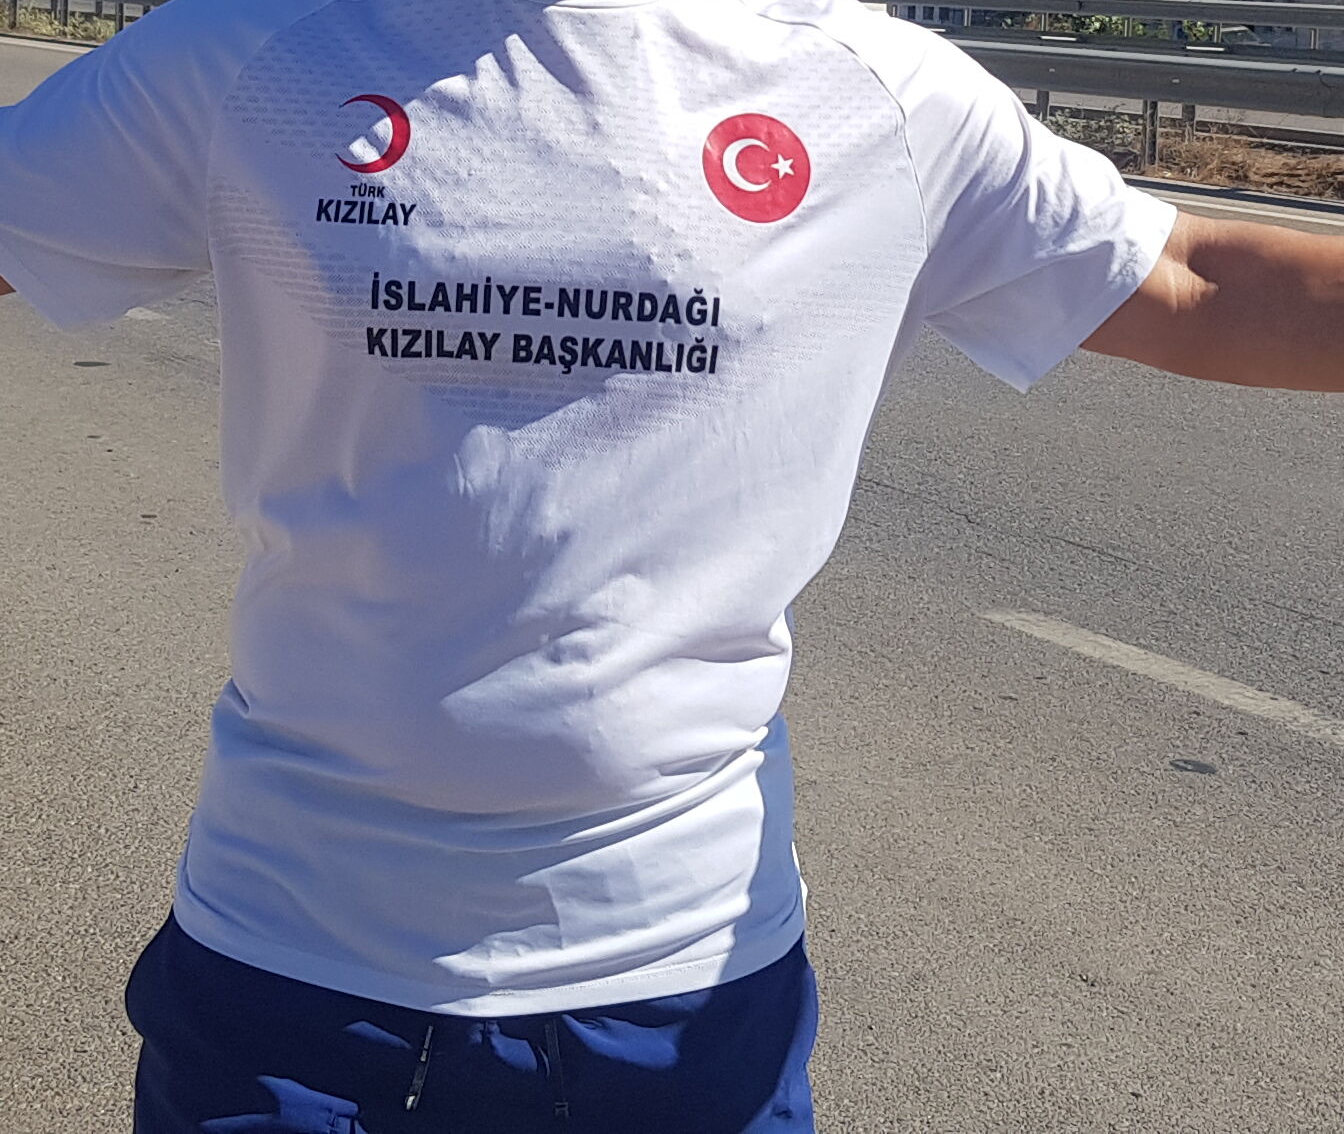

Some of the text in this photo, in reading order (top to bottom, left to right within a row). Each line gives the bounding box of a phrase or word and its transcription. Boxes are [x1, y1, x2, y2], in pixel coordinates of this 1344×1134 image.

[350, 182, 386, 198] TÜRK
[316, 198, 417, 226] KIZILAY
[371, 271, 720, 327] İSLAHİYE-NURDAĞI
[366, 327, 719, 374] KIZILAY BAŞKANLIĞI
